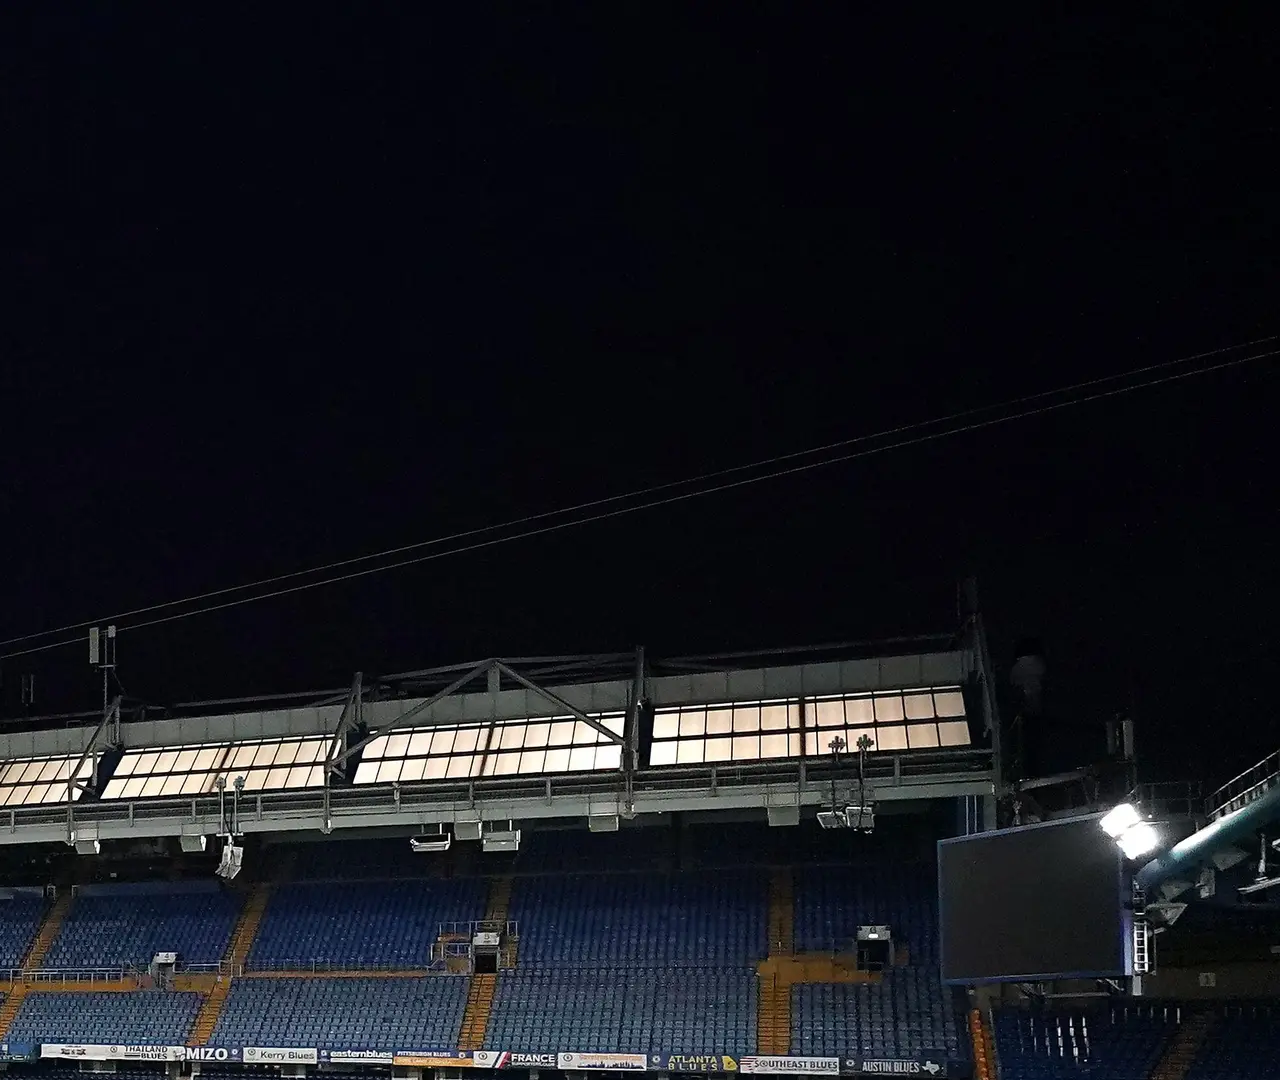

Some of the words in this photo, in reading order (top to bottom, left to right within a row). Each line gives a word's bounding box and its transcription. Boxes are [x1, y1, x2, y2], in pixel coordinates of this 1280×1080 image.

[186, 1048, 228, 1060] MIZO
[260, 1051, 286, 1060] Kerry
[288, 1052, 315, 1060] Blues
[330, 1049, 393, 1058] easternblues
[511, 1054, 556, 1062] FRANCE
[669, 1055, 717, 1063] ATLANTA
[809, 1061, 838, 1069] BLUES
[862, 1060, 892, 1071] AUSTIN
[893, 1061, 920, 1073] BLUES
